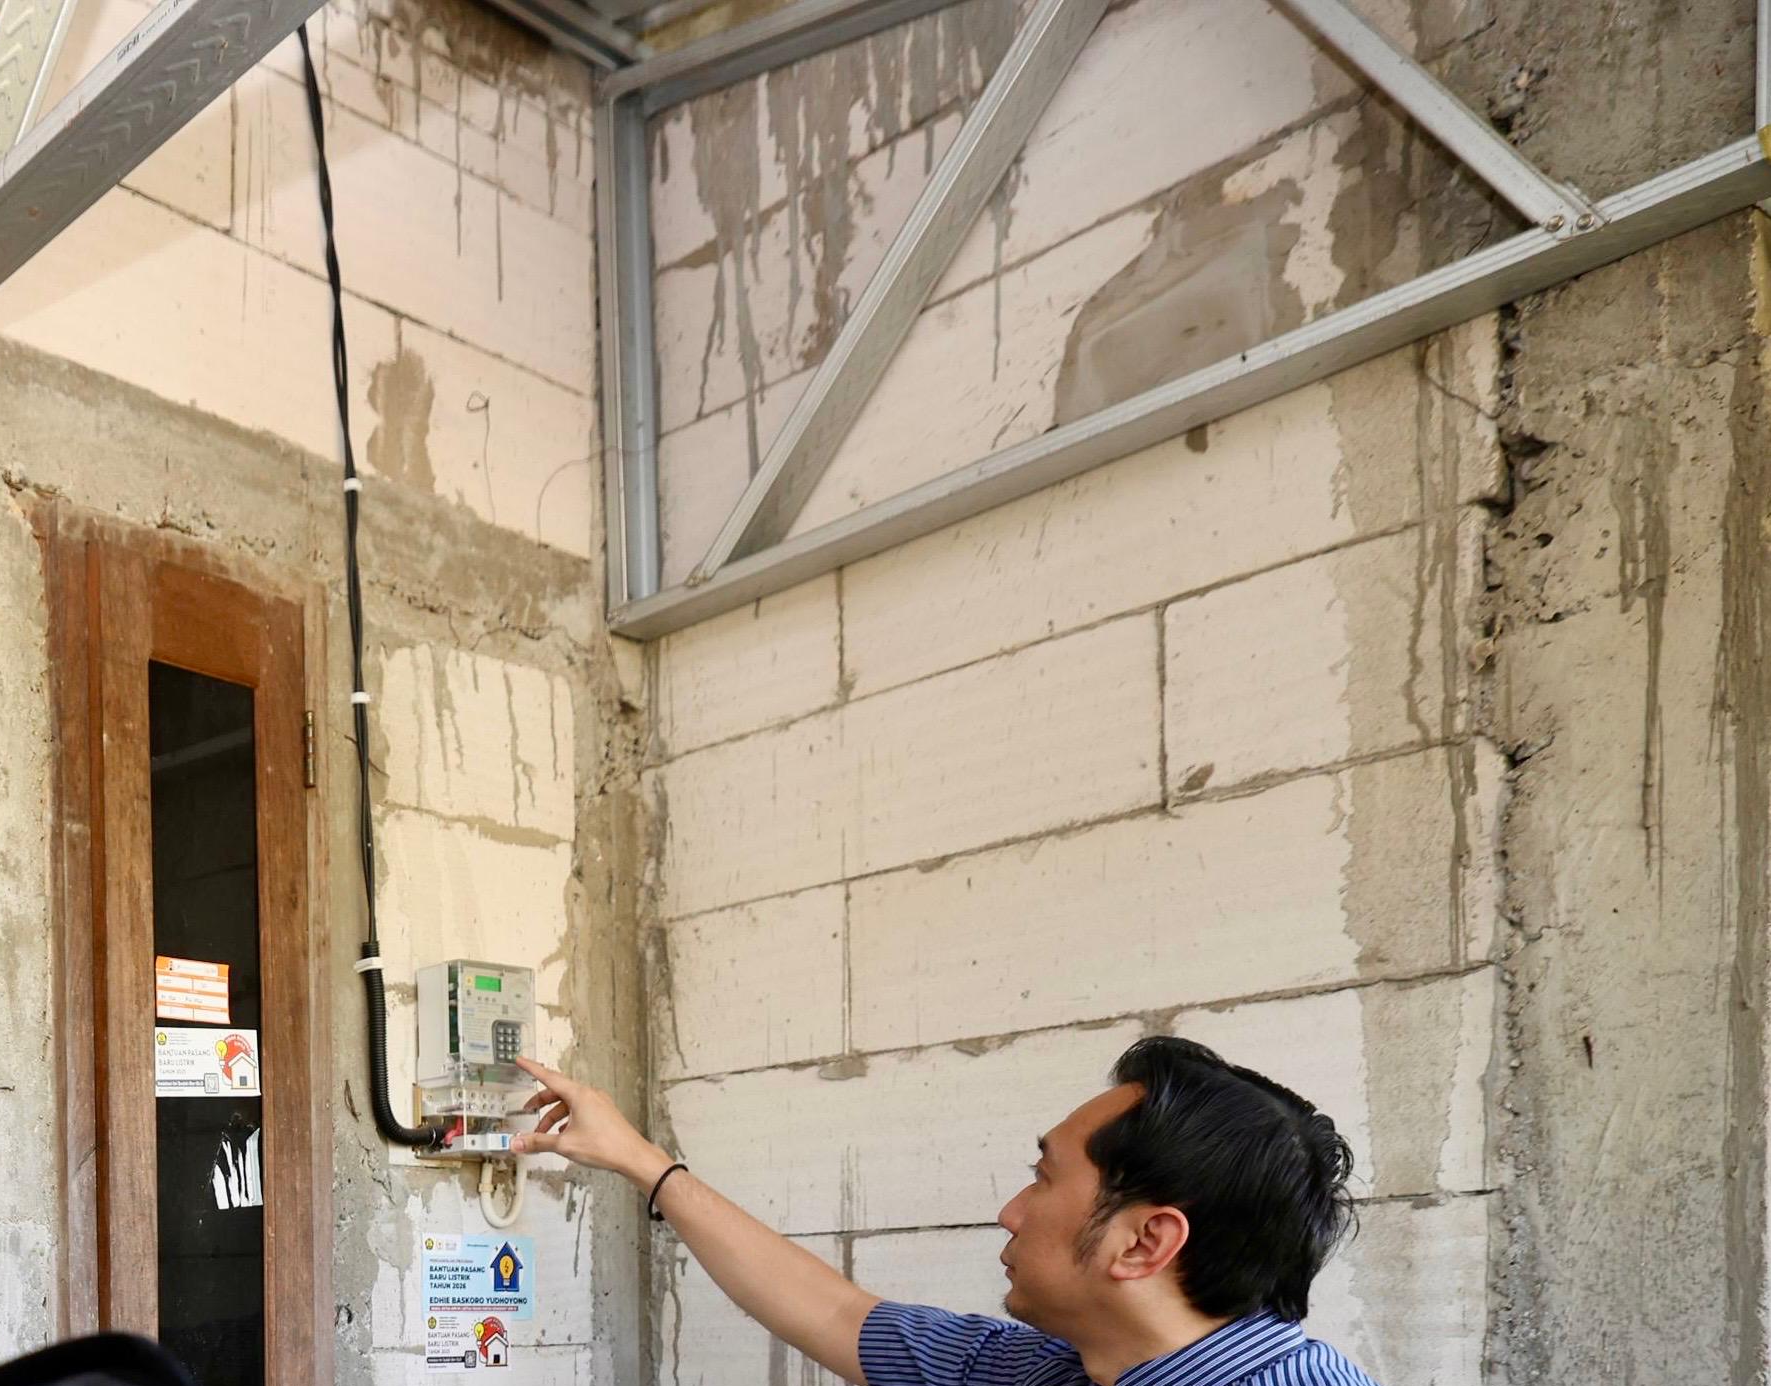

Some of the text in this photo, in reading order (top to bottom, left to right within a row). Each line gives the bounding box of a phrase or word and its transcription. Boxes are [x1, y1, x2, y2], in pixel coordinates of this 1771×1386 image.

[429, 1265, 486, 1273] BANTUAN PASANG
[429, 1296, 450, 1304] EDHIE
[451, 1296, 485, 1304] BASKORO
